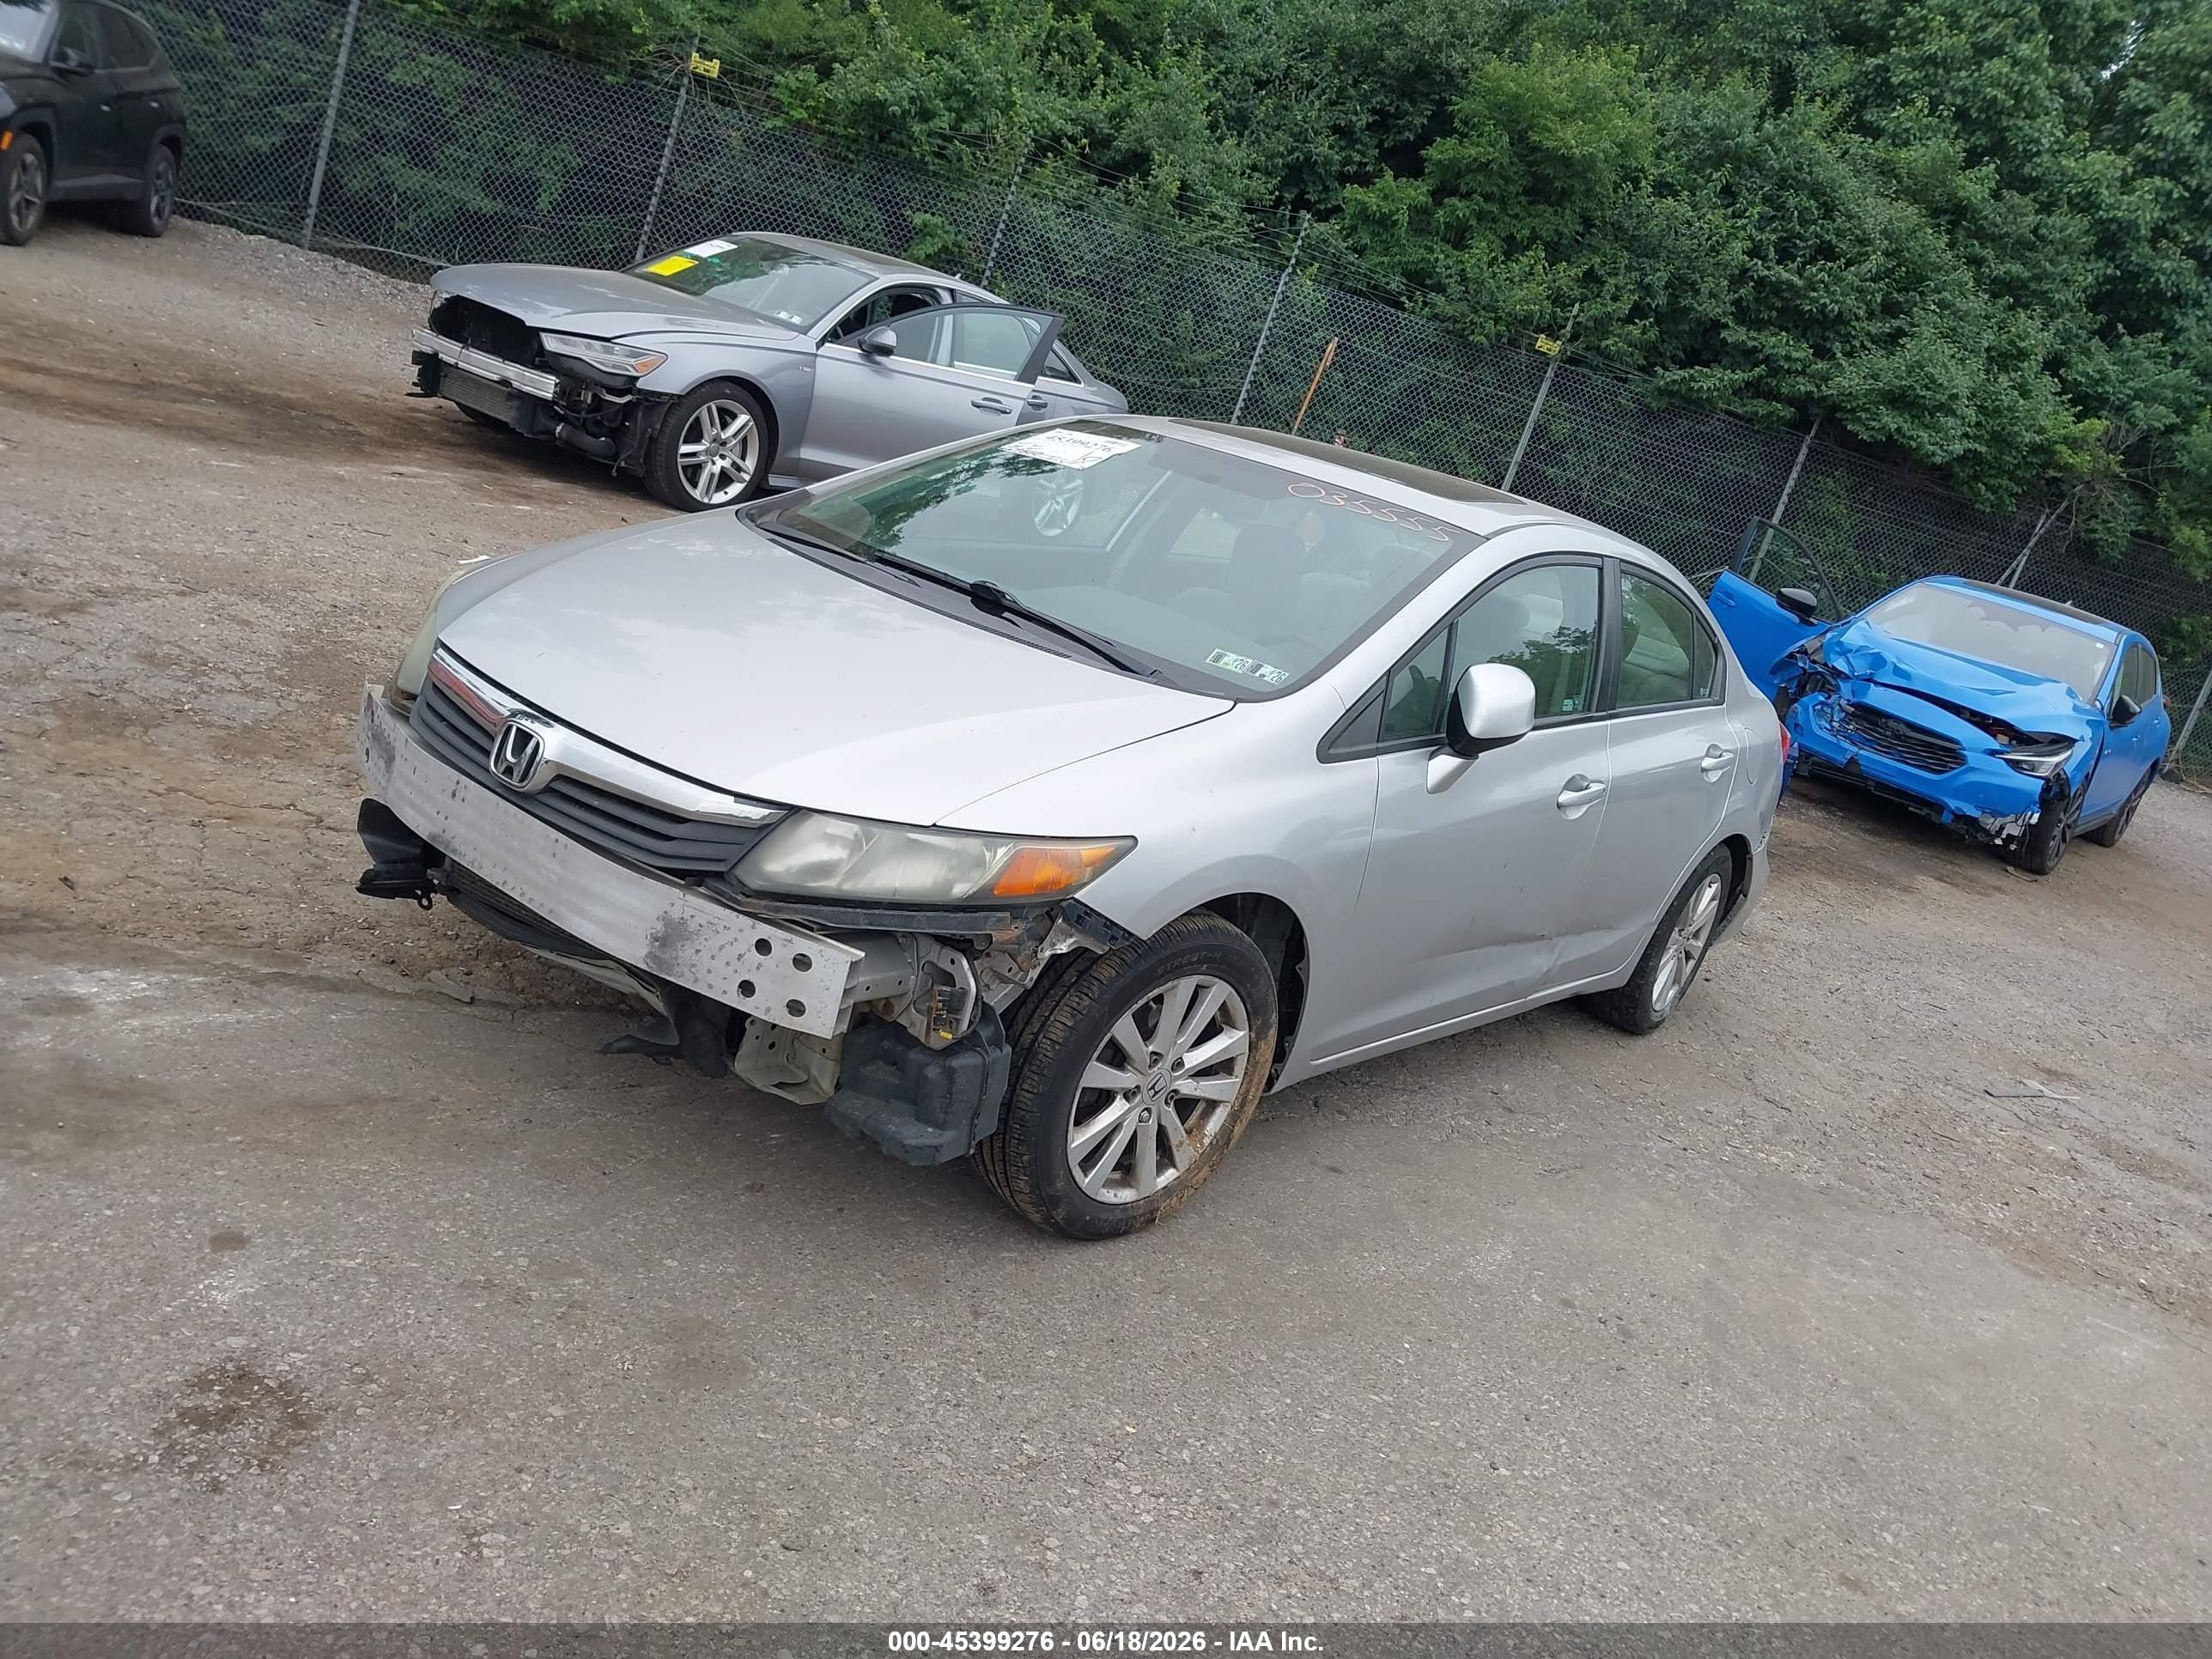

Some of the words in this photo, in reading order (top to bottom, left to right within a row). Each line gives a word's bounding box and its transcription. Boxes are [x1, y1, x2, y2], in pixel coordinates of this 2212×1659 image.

[1288, 483, 1461, 542] 035555
[1234, 659, 1249, 671] 26
[1271, 671, 1286, 683] 26
